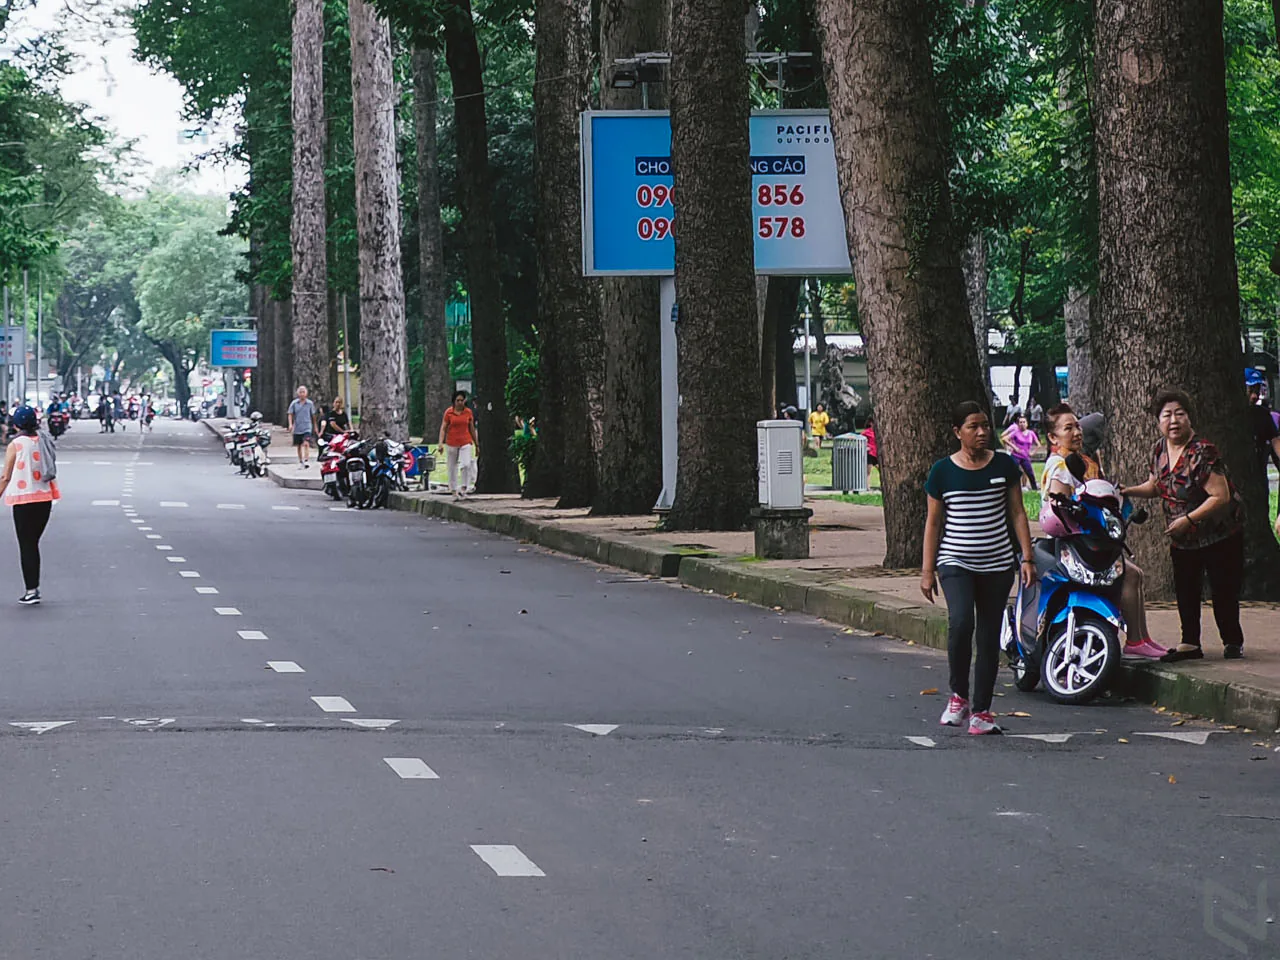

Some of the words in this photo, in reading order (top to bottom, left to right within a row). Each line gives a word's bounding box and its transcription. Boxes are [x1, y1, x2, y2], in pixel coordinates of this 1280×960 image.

[777, 125, 828, 135] PACIFI
[637, 161, 670, 174] CHO
[758, 184, 805, 206] 856
[759, 216, 805, 239] 578
